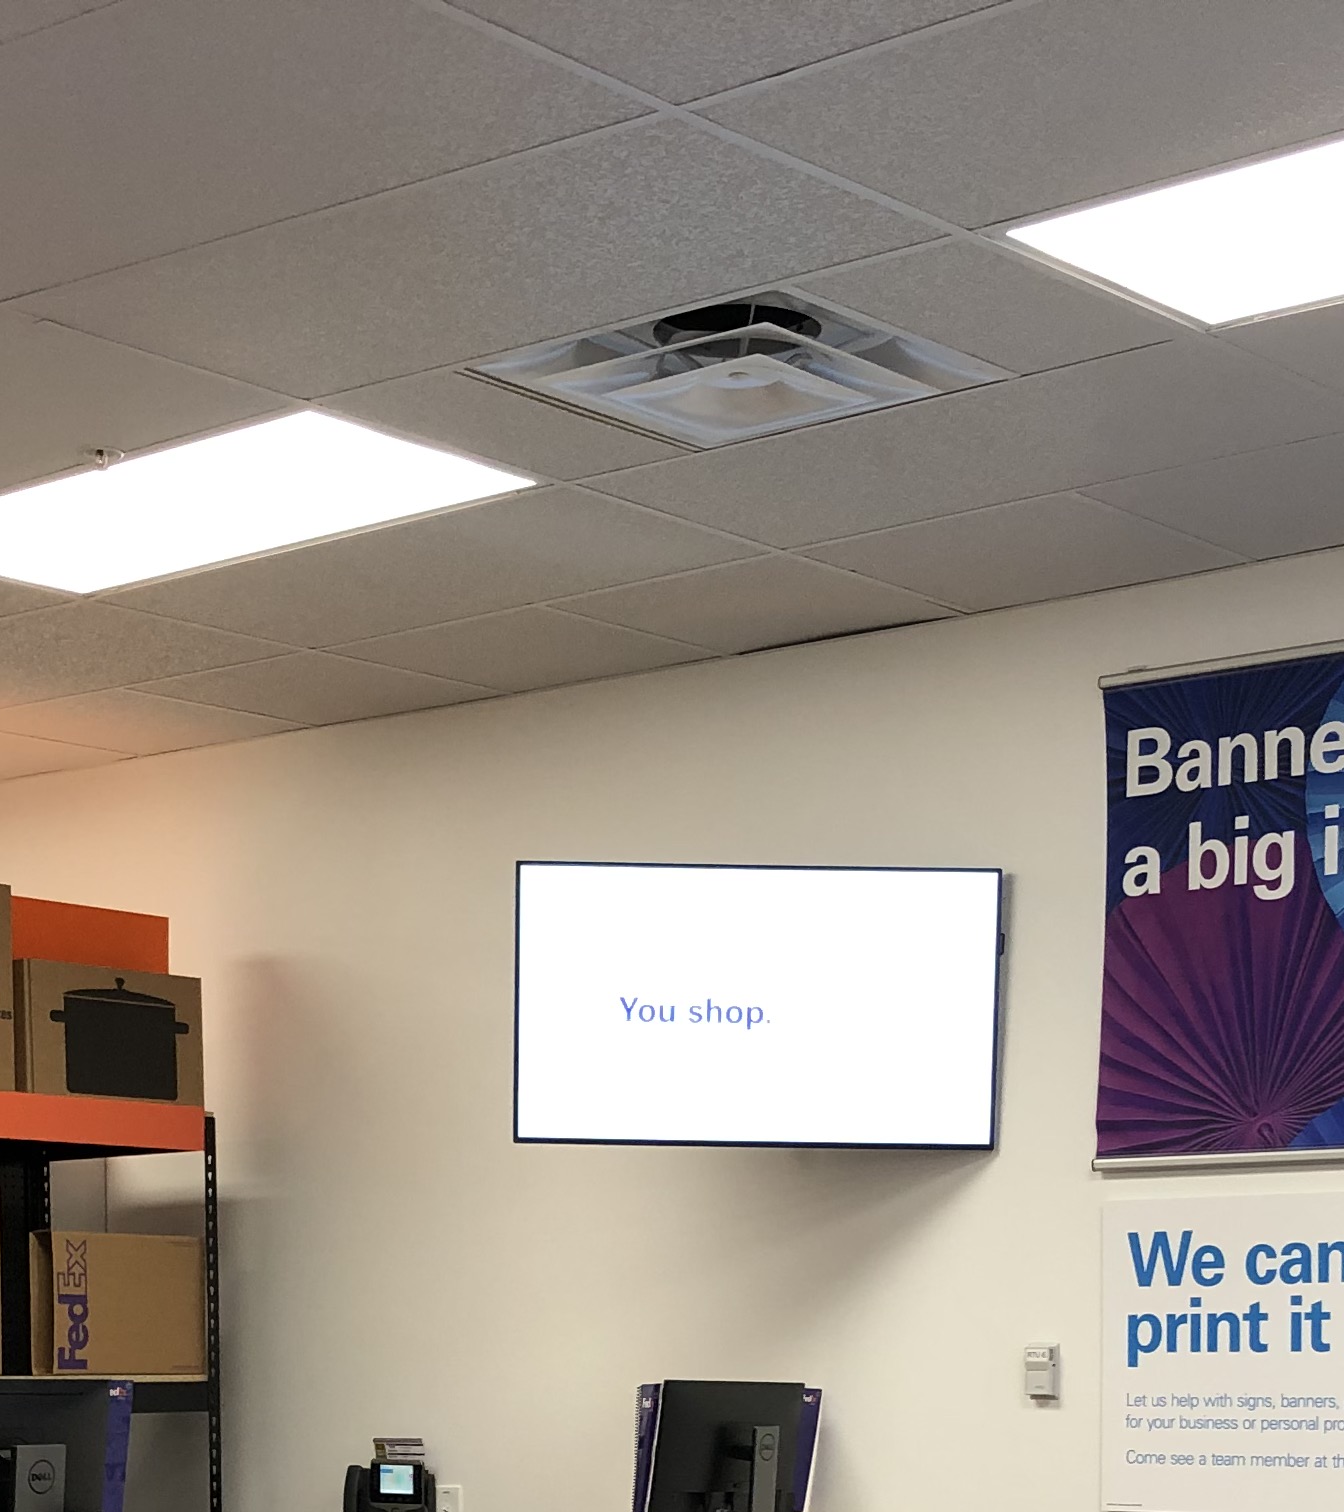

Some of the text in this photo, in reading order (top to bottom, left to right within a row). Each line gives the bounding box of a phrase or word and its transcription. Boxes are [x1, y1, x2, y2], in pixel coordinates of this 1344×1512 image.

[1121, 843, 1162, 898] a
[1187, 819, 1297, 901] big
[619, 996, 773, 1030] You shop.
[1127, 1230, 1225, 1288] We
[57, 1238, 89, 1371] FedEx
[1127, 1298, 1269, 1368] print
[1289, 1295, 1330, 1353] it
[109, 1387, 128, 1398] edEx
[1126, 1392, 1147, 1408] Let
[1151, 1395, 1167, 1408] us
[1171, 1393, 1199, 1410] help
[1203, 1393, 1233, 1408] with
[1237, 1393, 1276, 1411] signs,
[1281, 1394, 1340, 1410] banners,
[1126, 1414, 1143, 1429] for
[1147, 1416, 1175, 1432] your
[1179, 1415, 1239, 1431] business
[1242, 1418, 1256, 1430] or
[1260, 1416, 1320, 1433] personal
[1126, 1449, 1166, 1465] Come
[1170, 1454, 1194, 1466] see
[1198, 1454, 1207, 1466] a
[1211, 1453, 1246, 1466] team
[1250, 1453, 1311, 1468] member
[1314, 1455, 1328, 1468] at
[31, 1472, 52, 1483] DELL
